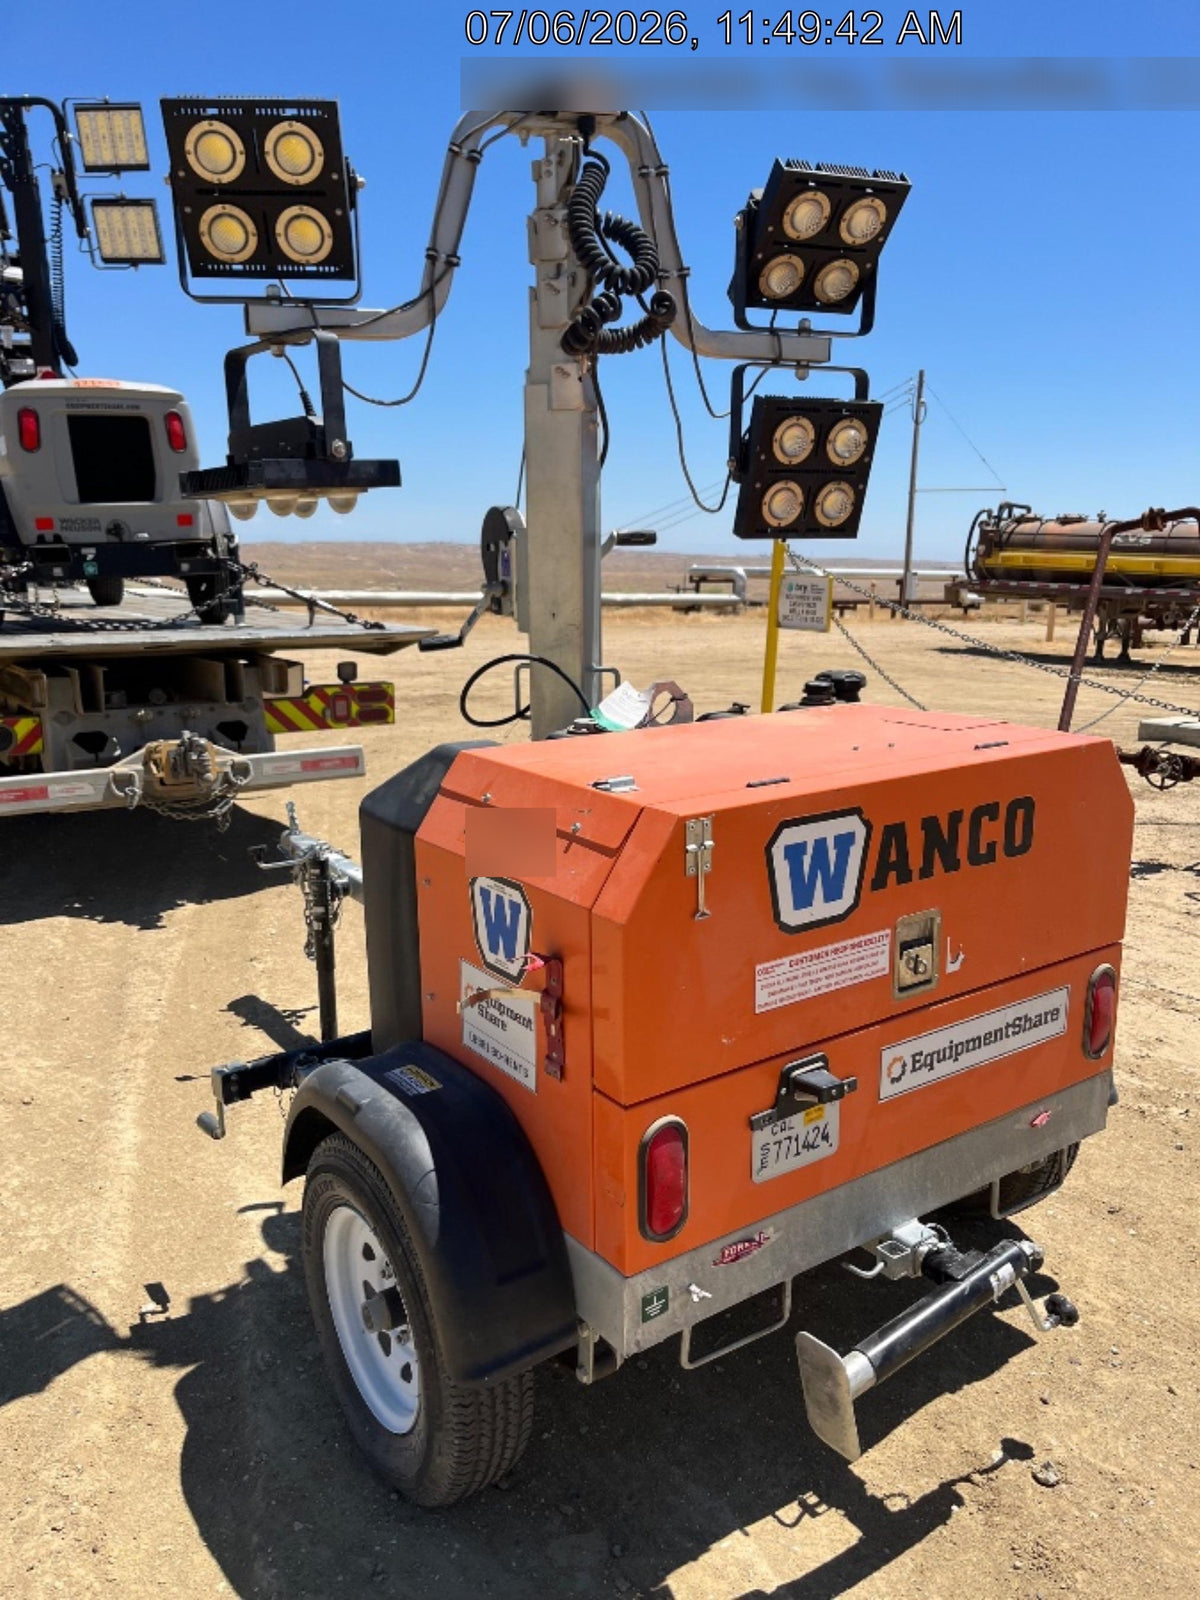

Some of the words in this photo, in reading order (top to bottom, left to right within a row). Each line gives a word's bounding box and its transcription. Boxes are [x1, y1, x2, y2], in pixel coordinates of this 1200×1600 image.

[784, 795, 1036, 911] WANCO
[480, 886, 521, 964] W
[910, 1003, 1062, 1073] EquipmentShare
[771, 1119, 795, 1136] CAL
[773, 1121, 831, 1165] 771424
